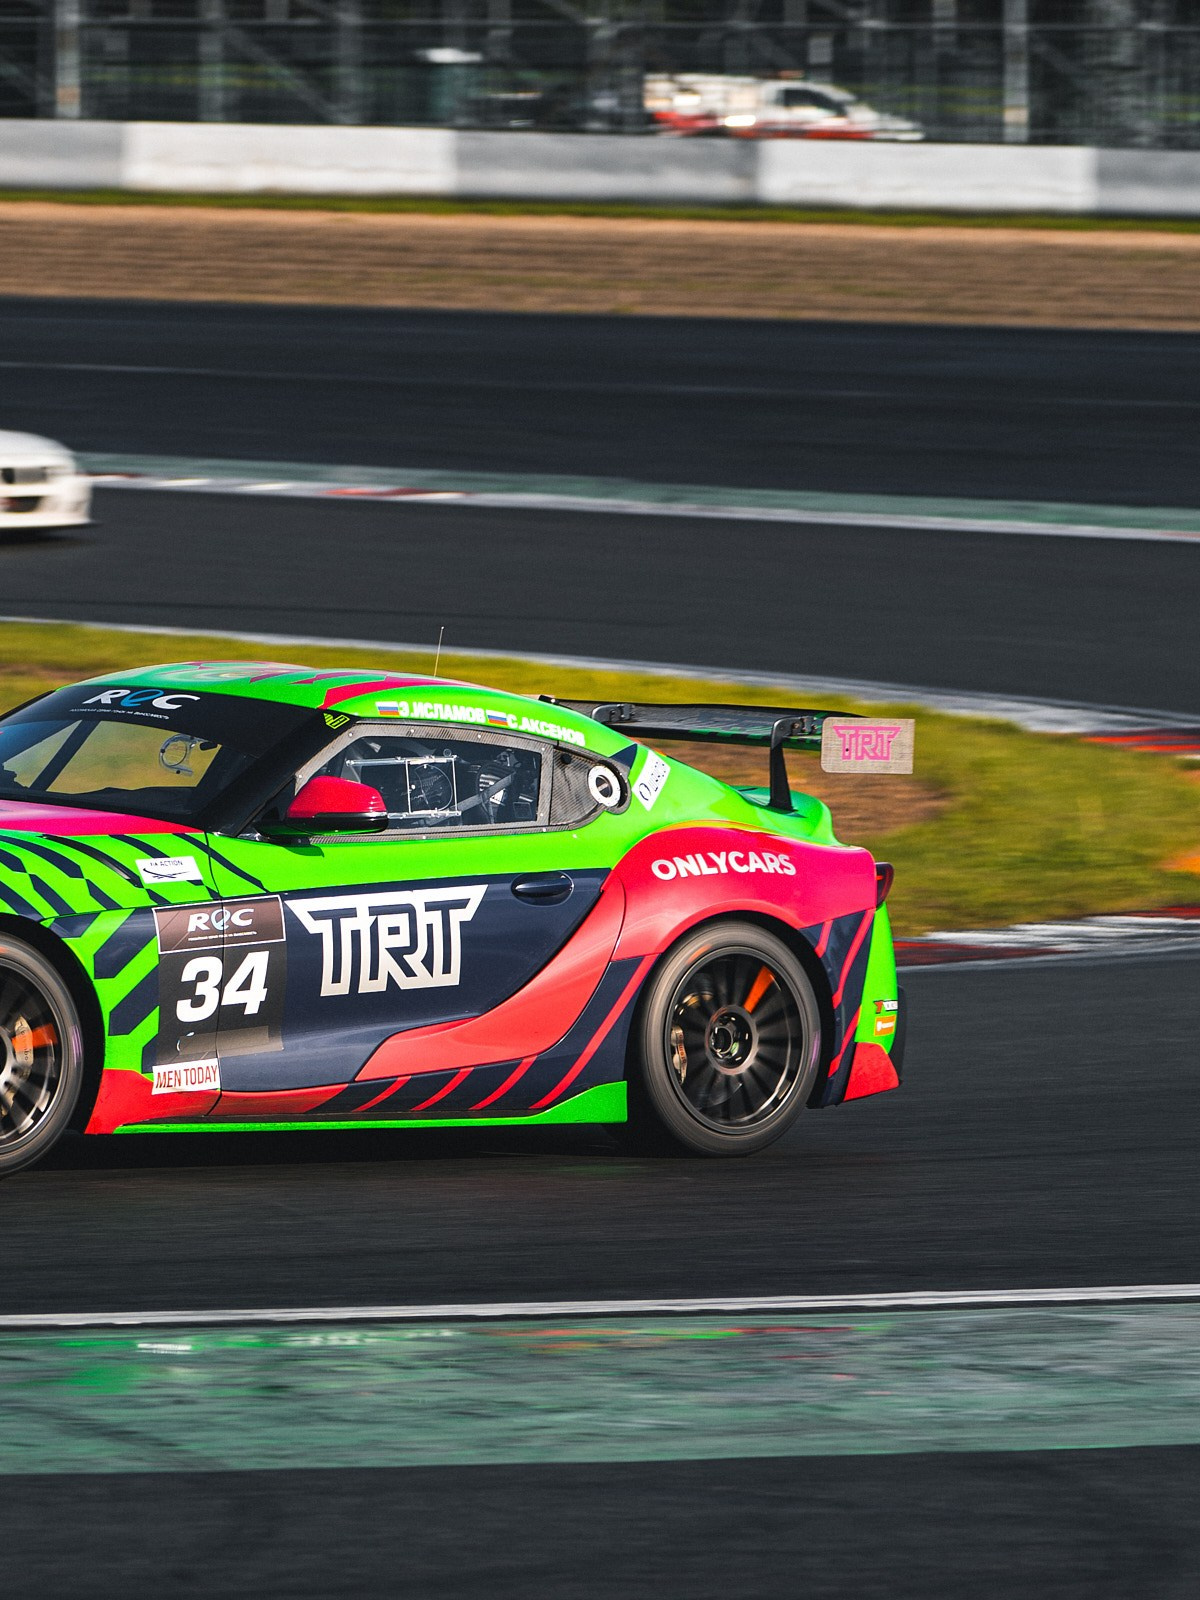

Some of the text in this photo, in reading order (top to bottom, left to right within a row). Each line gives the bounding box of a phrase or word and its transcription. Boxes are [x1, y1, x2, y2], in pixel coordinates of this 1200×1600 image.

[832, 726, 902, 761] TRT
[651, 851, 797, 881] ONLYCARS
[284, 884, 488, 996] TRT
[176, 951, 269, 1022] 34
[156, 1065, 218, 1089] MEN TODAY
